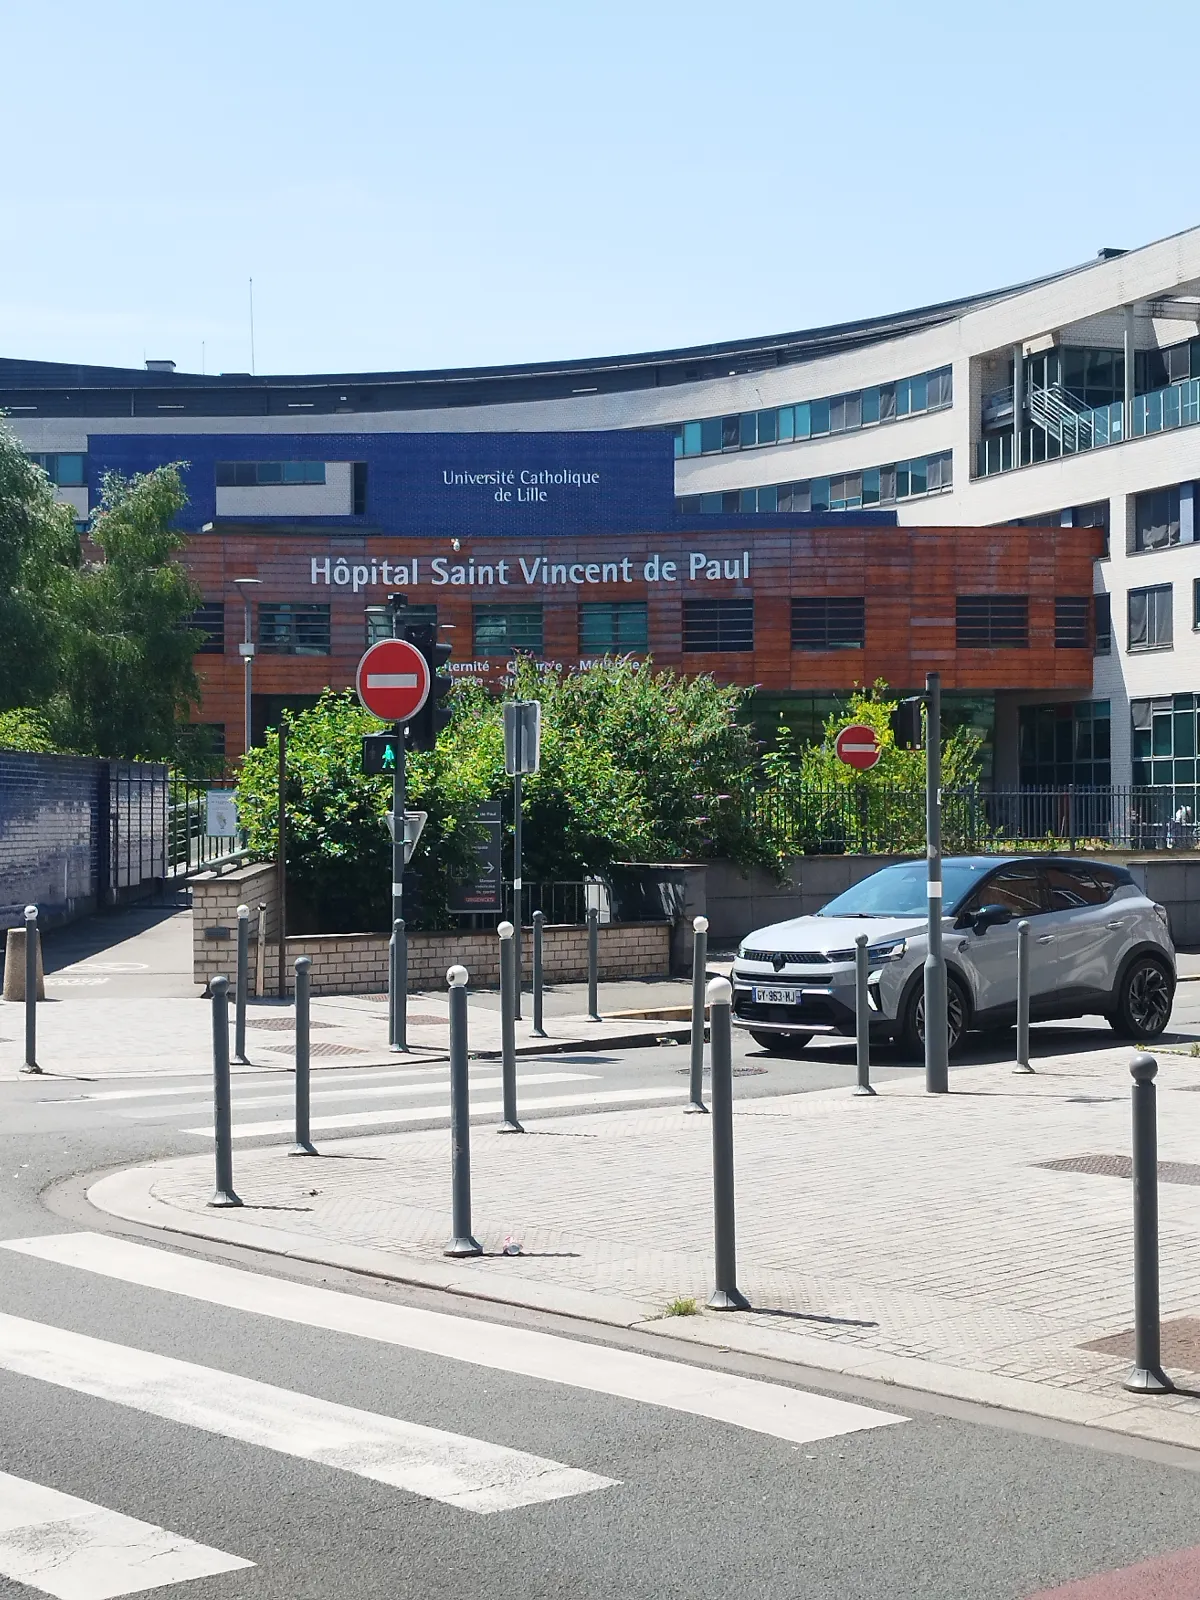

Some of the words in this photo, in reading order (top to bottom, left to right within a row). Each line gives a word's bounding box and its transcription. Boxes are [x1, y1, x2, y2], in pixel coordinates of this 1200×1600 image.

[443, 470, 515, 485] Université
[520, 470, 600, 487] Catholique
[494, 487, 512, 502] de
[518, 487, 548, 502] Lille
[311, 557, 418, 593] Hôpital
[431, 558, 509, 585] Saint
[518, 557, 633, 585] Vincent
[643, 554, 677, 582] de
[689, 551, 749, 581] Paul
[446, 660, 490, 672] ternité
